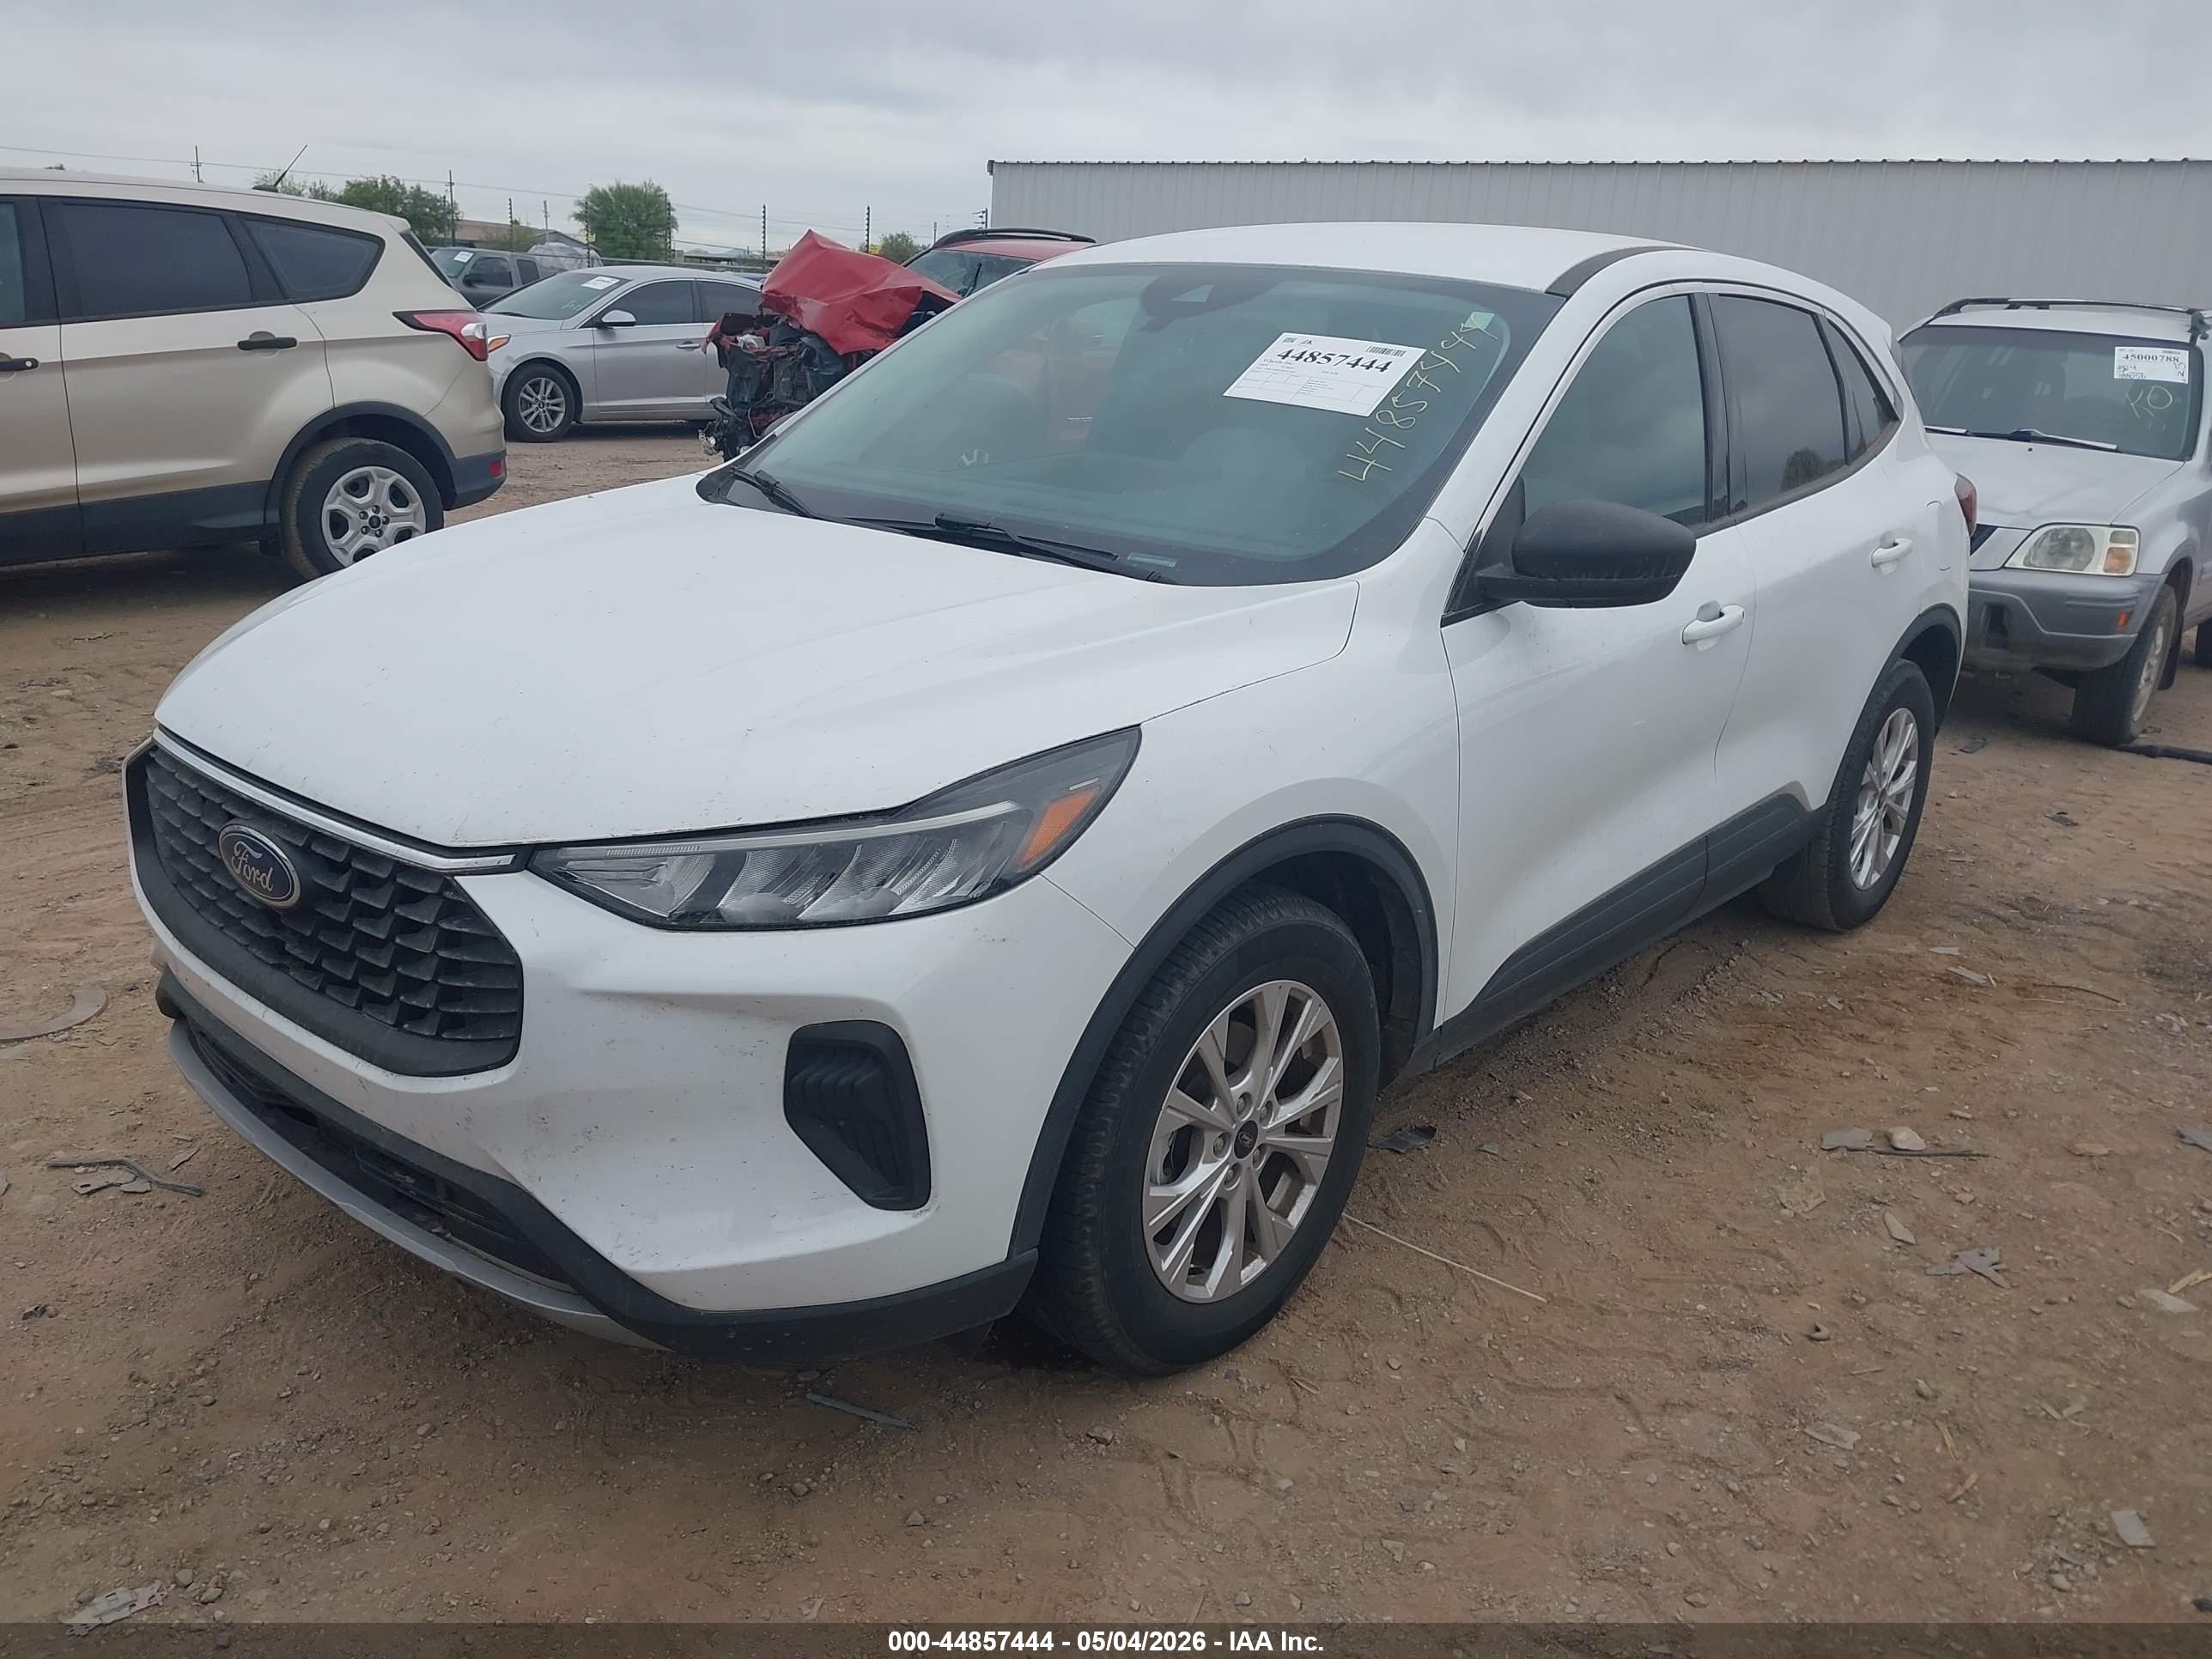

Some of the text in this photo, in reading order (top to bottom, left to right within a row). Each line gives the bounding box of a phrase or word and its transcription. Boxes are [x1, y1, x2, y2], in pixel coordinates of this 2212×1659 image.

[1277, 348, 1394, 374] 44857444
[2122, 353, 2180, 362] 45000788
[231, 840, 274, 892] Ford
